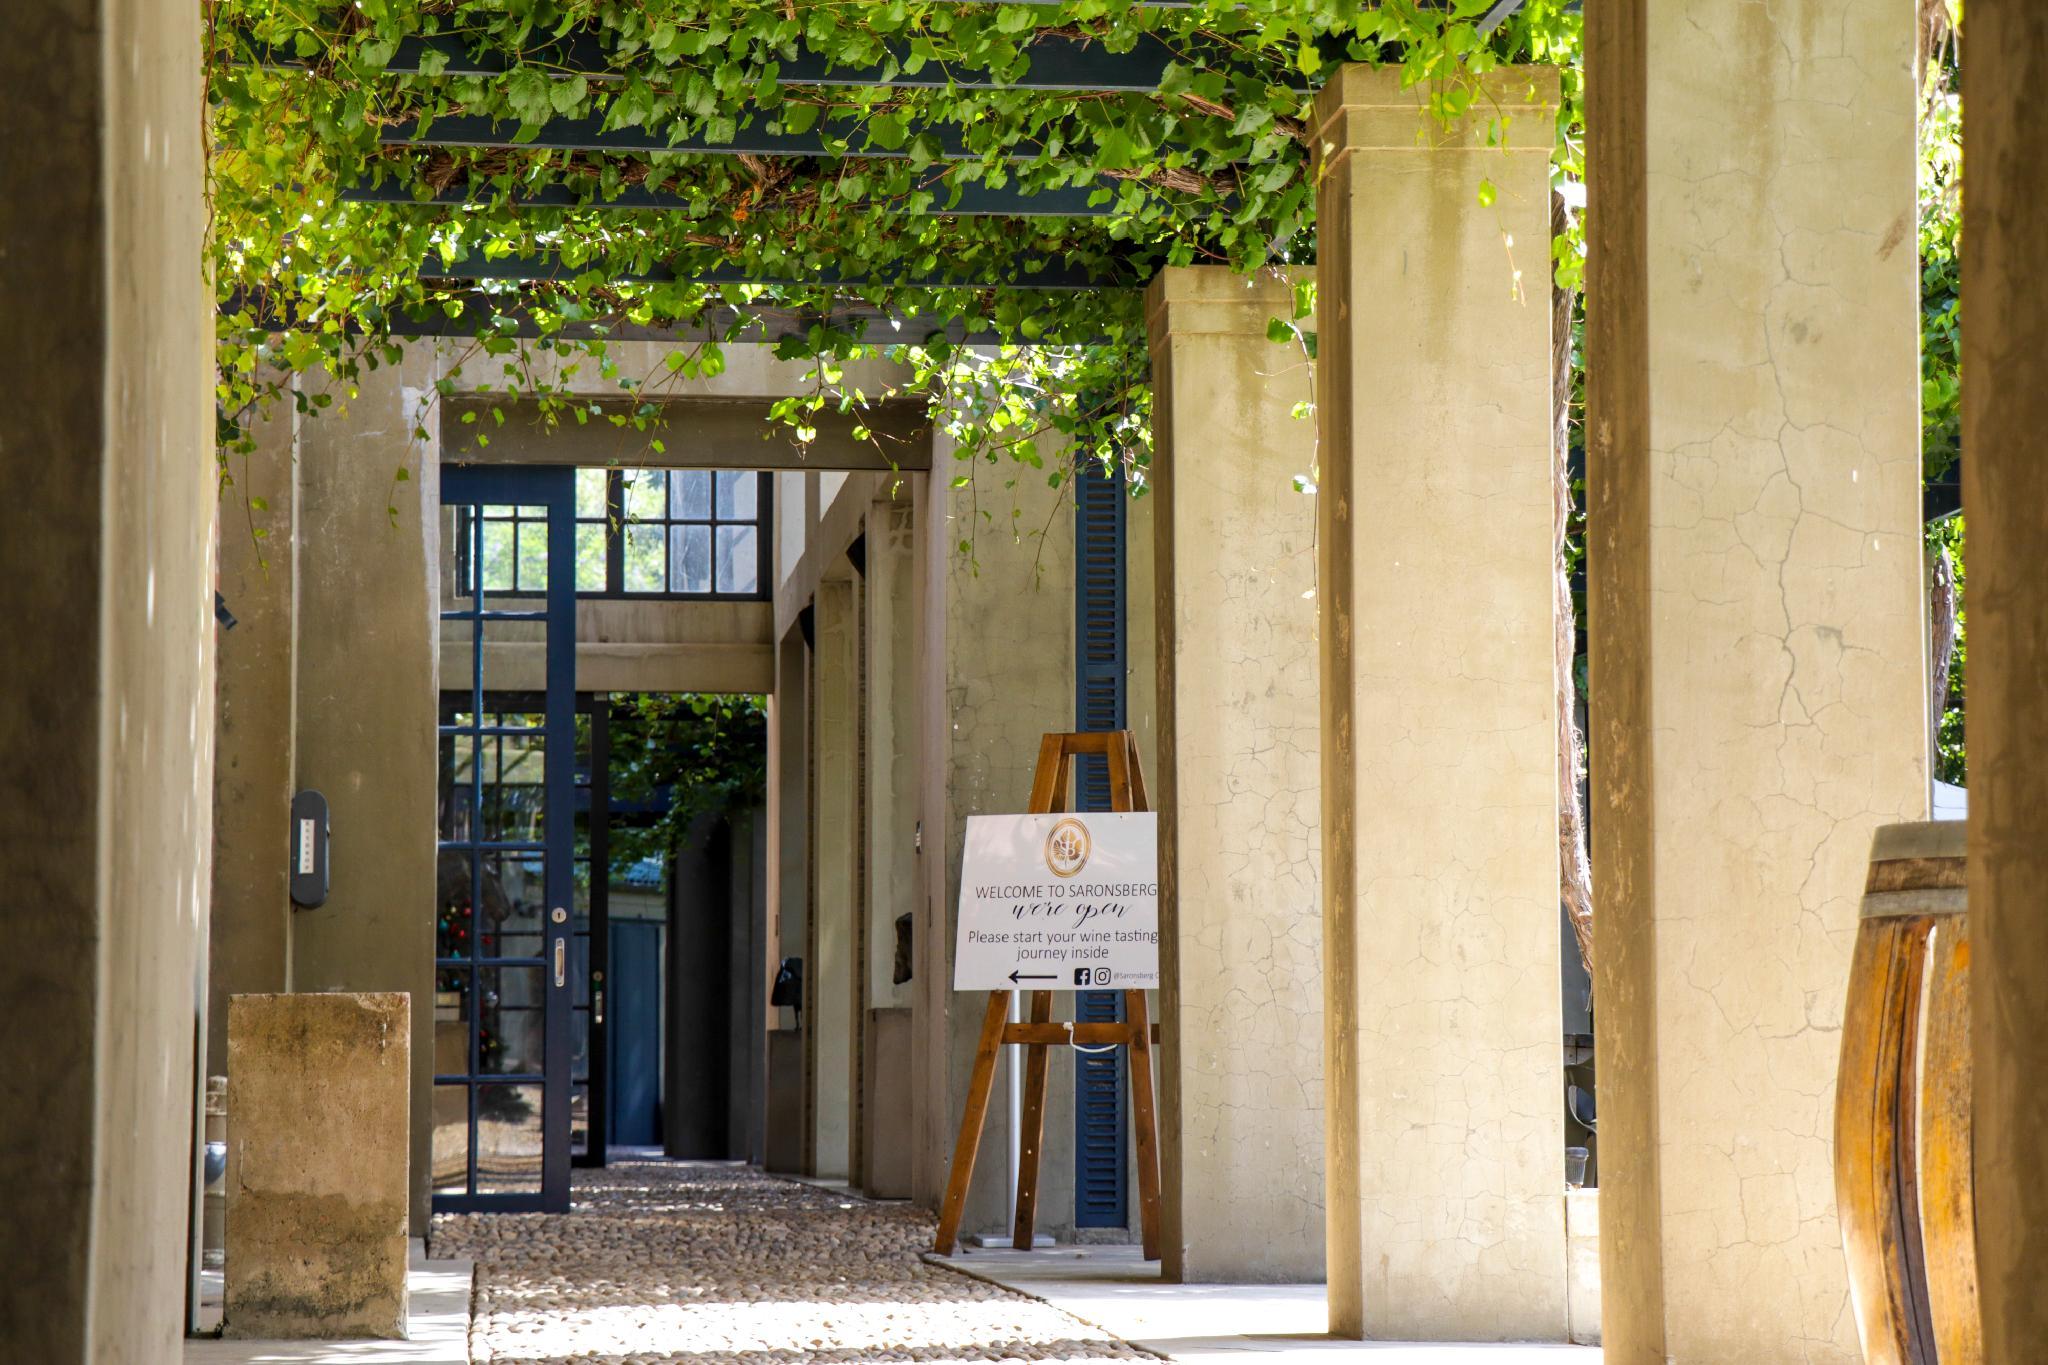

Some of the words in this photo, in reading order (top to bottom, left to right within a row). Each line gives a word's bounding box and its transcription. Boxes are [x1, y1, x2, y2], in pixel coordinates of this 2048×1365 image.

[976, 885, 1043, 898] WELCOME
[1049, 885, 1065, 898] TO
[1069, 884, 1157, 898] SARONSBERG
[1072, 902, 1133, 929] open
[968, 930, 1010, 943] Please
[1013, 931, 1042, 943] start
[1048, 933, 1076, 945] your
[1080, 931, 1111, 942] wine
[1115, 929, 1158, 944] tasting
[1016, 947, 1067, 962] journey
[1071, 946, 1109, 959] inside
